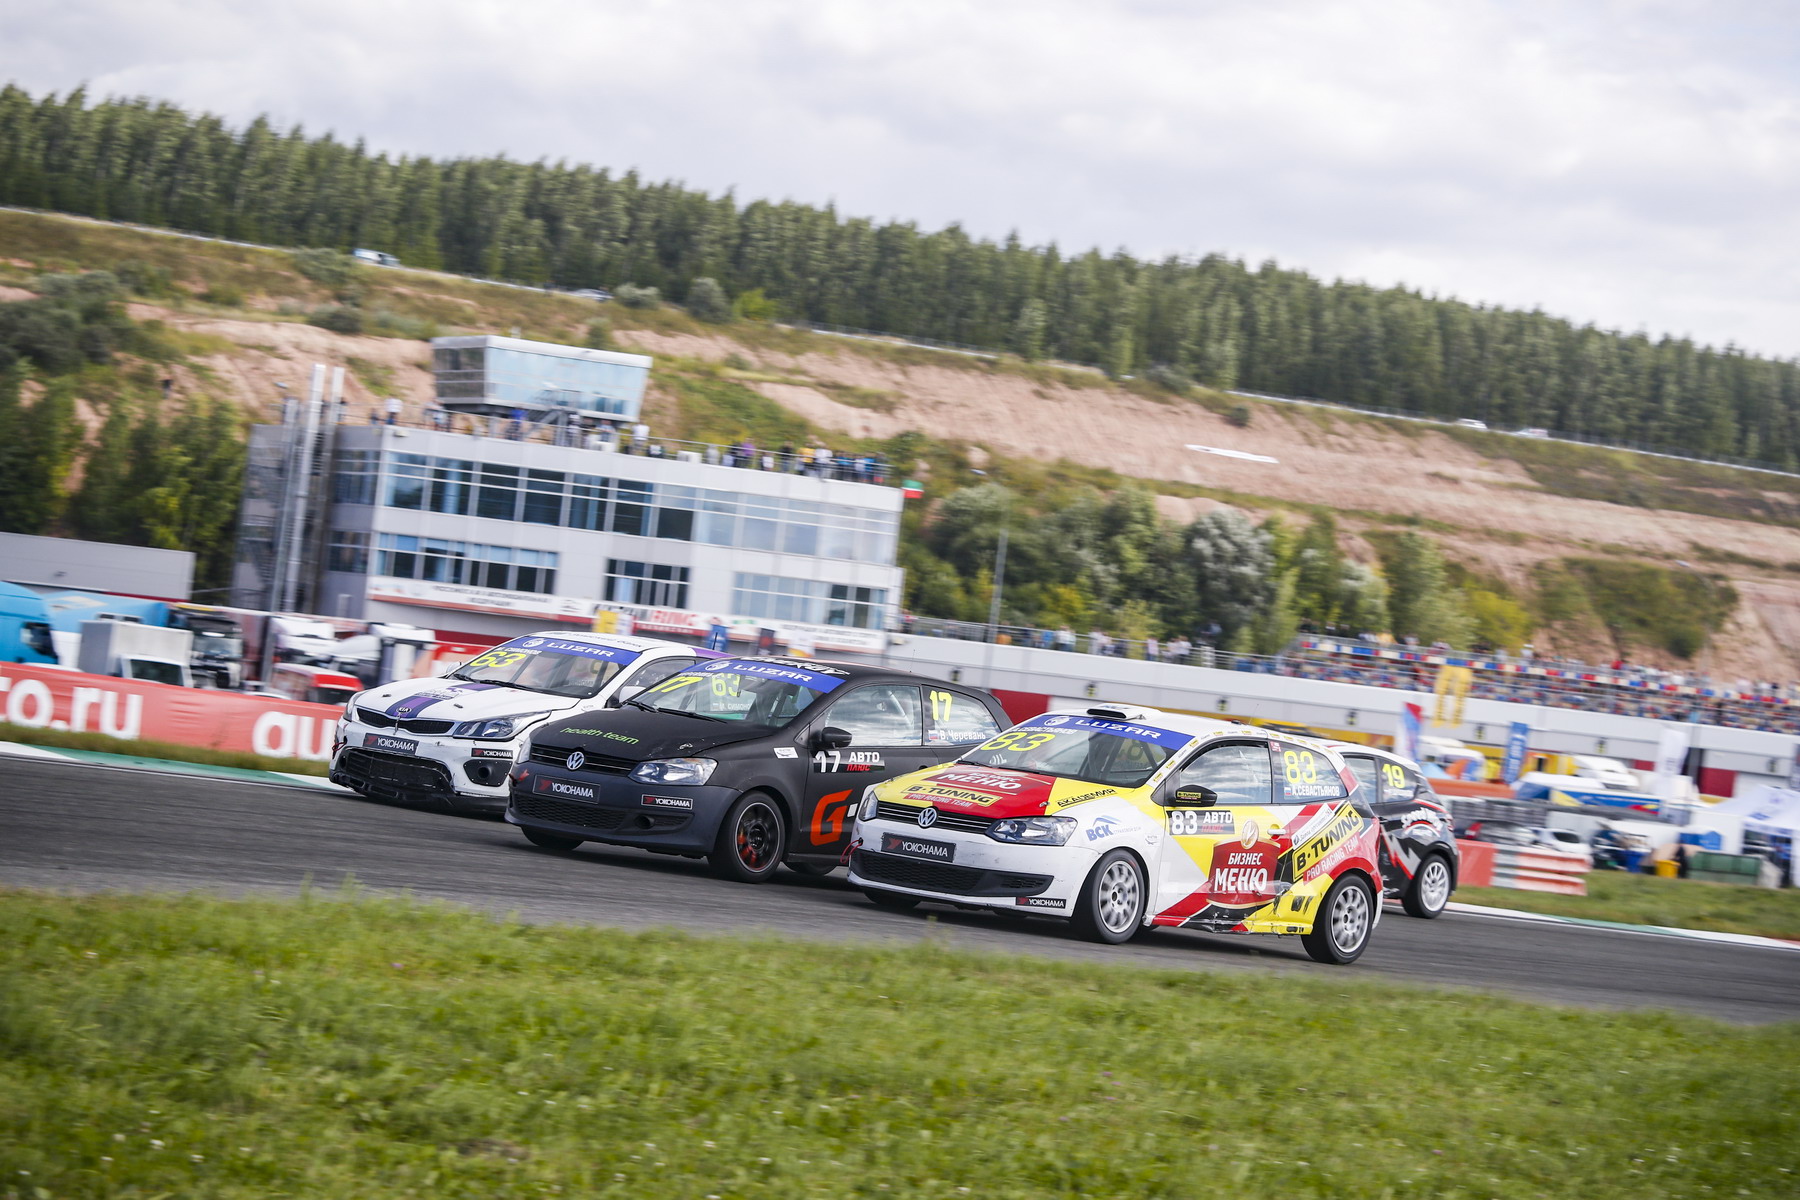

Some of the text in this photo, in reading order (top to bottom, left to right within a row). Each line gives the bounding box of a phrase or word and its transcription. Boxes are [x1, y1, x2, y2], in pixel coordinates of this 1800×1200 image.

[546, 642, 615, 657] LUZAR
[470, 651, 527, 668] 63
[733, 664, 813, 682] LUZAR
[648, 676, 704, 693] 17
[712, 672, 741, 697] 63
[929, 690, 953, 721] 17
[560, 727, 640, 745] health team
[940, 730, 986, 742] В.Черевань
[1075, 719, 1163, 739] LUZAR
[377, 738, 414, 751] YOKOHAMA
[981, 732, 1056, 751] 83
[483, 750, 512, 758] YOKOHAMA
[815, 750, 842, 773] 17
[848, 752, 880, 763] АВТО
[1284, 751, 1317, 784] 83
[1382, 764, 1405, 788] 19
[937, 773, 1022, 790] МЕНЮ
[551, 783, 594, 798] YOKOHAMA
[1292, 784, 1341, 797] А.СЕВАСТЬЯНОВ
[654, 798, 690, 807] YOKOHAMA
[928, 796, 951, 805] RACING
[951, 799, 974, 808] TEAM
[1171, 810, 1198, 834] 83
[1203, 811, 1233, 823] АВТО
[1086, 824, 1113, 842] ВСК
[901, 841, 948, 857] YOKOHAMA
[1228, 852, 1264, 866] БИЗНЕС
[1306, 836, 1359, 883] PRO RACING TEAM
[1214, 868, 1268, 893] МЕНЮ
[1028, 898, 1065, 908] YOKOHAMA
